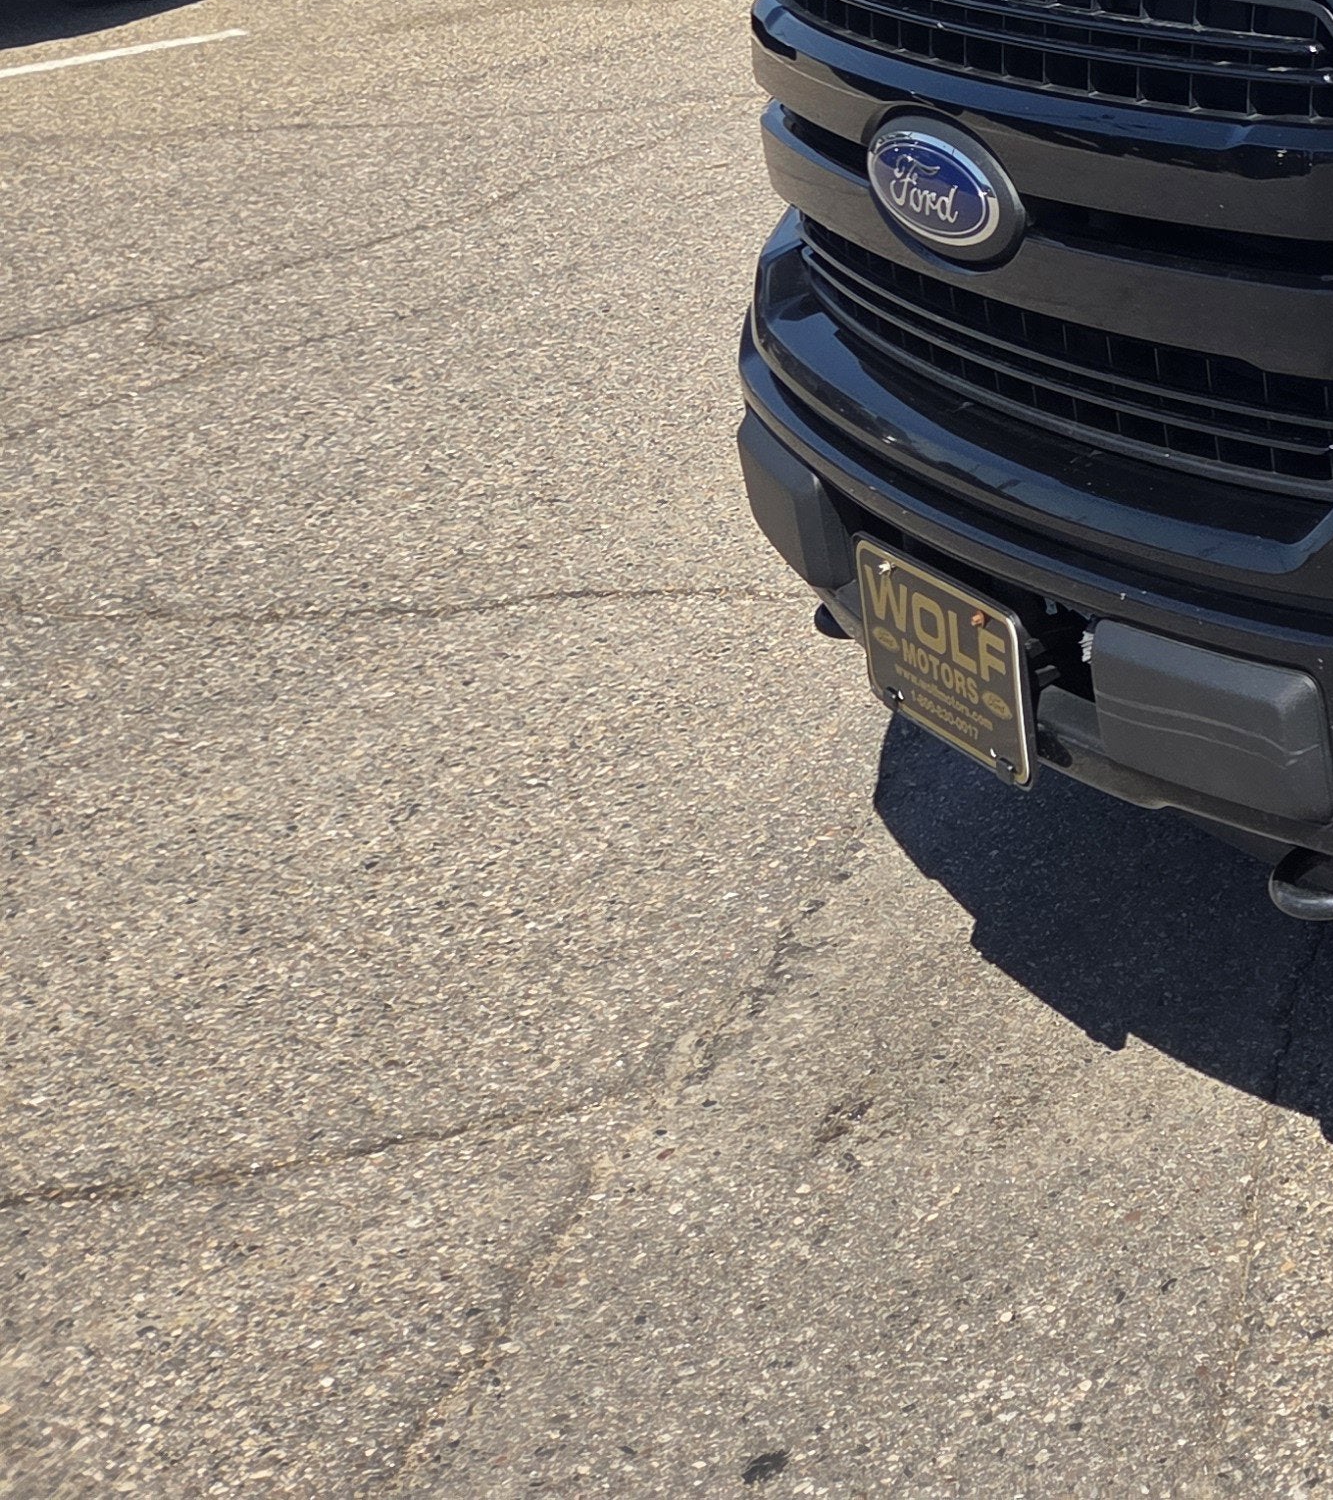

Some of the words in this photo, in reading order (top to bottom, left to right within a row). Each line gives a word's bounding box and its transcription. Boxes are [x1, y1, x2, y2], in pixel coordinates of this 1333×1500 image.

[889, 153, 959, 224] Ford
[864, 563, 1007, 682] WOLF
[901, 638, 979, 705] MOTORS
